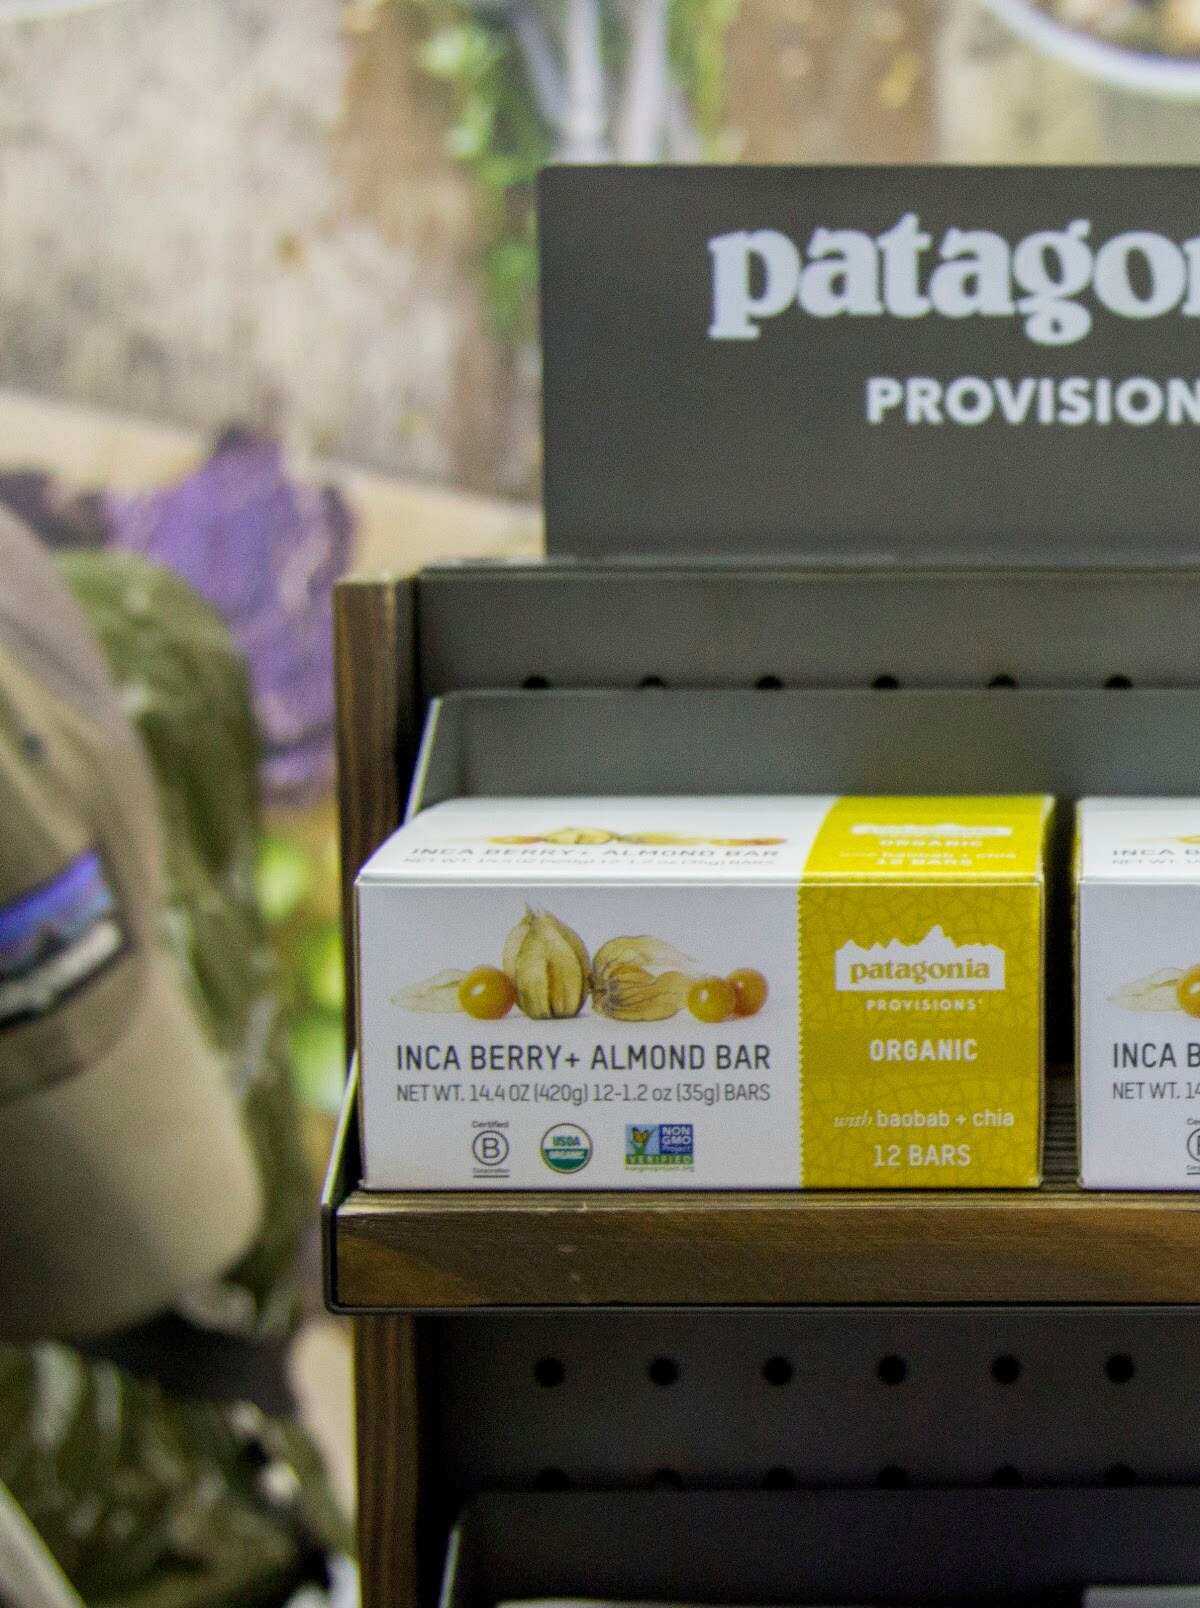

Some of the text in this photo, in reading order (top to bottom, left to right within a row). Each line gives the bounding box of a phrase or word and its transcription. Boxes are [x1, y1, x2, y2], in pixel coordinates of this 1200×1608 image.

[850, 958, 990, 985] patagonia
[397, 1045, 461, 1070] INCA
[590, 1044, 705, 1070] ALMOND
[716, 1044, 771, 1070] BAR
[869, 1039, 978, 1062] ORGANIC
[1113, 1042, 1177, 1068] INCA
[397, 1084, 429, 1101] NET
[433, 1084, 465, 1101] WT.
[470, 1084, 505, 1101] 14.4
[509, 1084, 530, 1101] OZ
[534, 1083, 589, 1106] (420g)
[652, 1088, 672, 1101] oz
[676, 1083, 719, 1106] (35g)
[724, 1084, 771, 1101] BARS
[1112, 1082, 1146, 1099] NET
[1149, 1082, 1181, 1099] WT.
[876, 1109, 950, 1128] baobab
[972, 1108, 1015, 1128] chia
[662, 1126, 691, 1135] NON
[662, 1135, 691, 1145] GMO
[483, 1137, 500, 1159] B
[873, 1144, 971, 1167] 12 BARS
